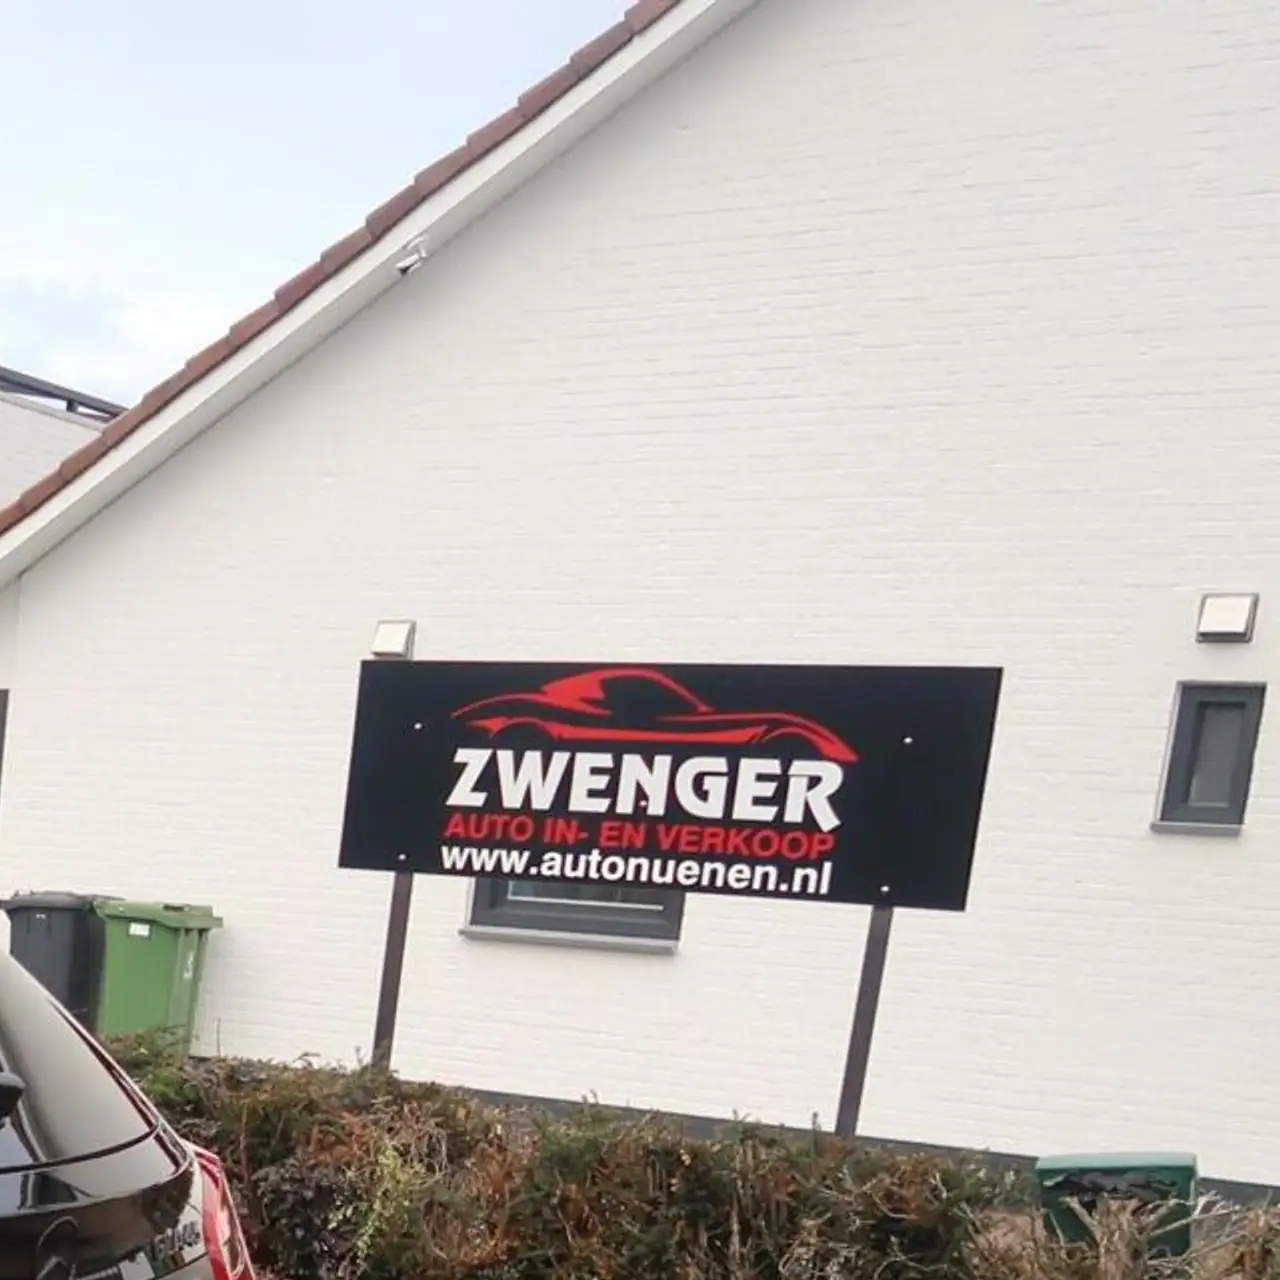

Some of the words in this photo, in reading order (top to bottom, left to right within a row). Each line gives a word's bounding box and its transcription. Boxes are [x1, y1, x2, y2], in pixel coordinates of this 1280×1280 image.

[445, 747, 844, 833] ZWENGER
[444, 812, 534, 842] AUTO
[543, 817, 589, 845] IN-
[599, 820, 647, 849] EN
[657, 824, 836, 861] VERKOOP
[441, 845, 834, 896] www.autonuenen.nl
